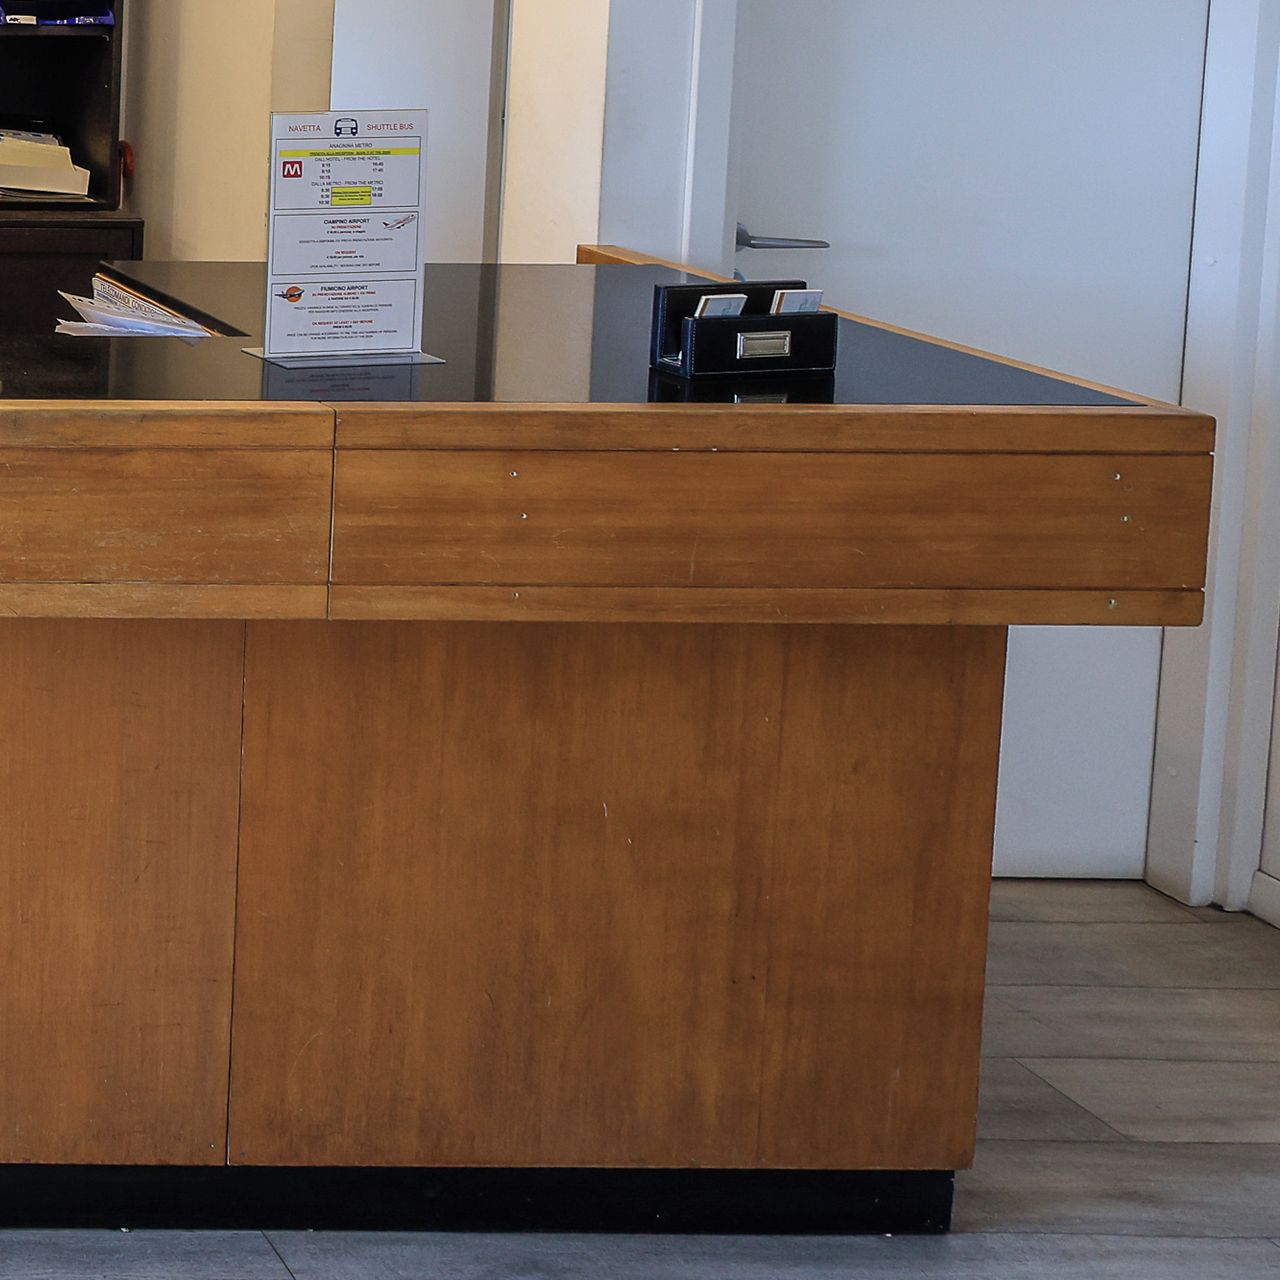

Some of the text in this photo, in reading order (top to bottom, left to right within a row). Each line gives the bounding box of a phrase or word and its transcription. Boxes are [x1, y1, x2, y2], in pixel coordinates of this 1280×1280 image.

[288, 124, 321, 132] NAVETTA
[366, 122, 415, 131] SHUTTLE BUS
